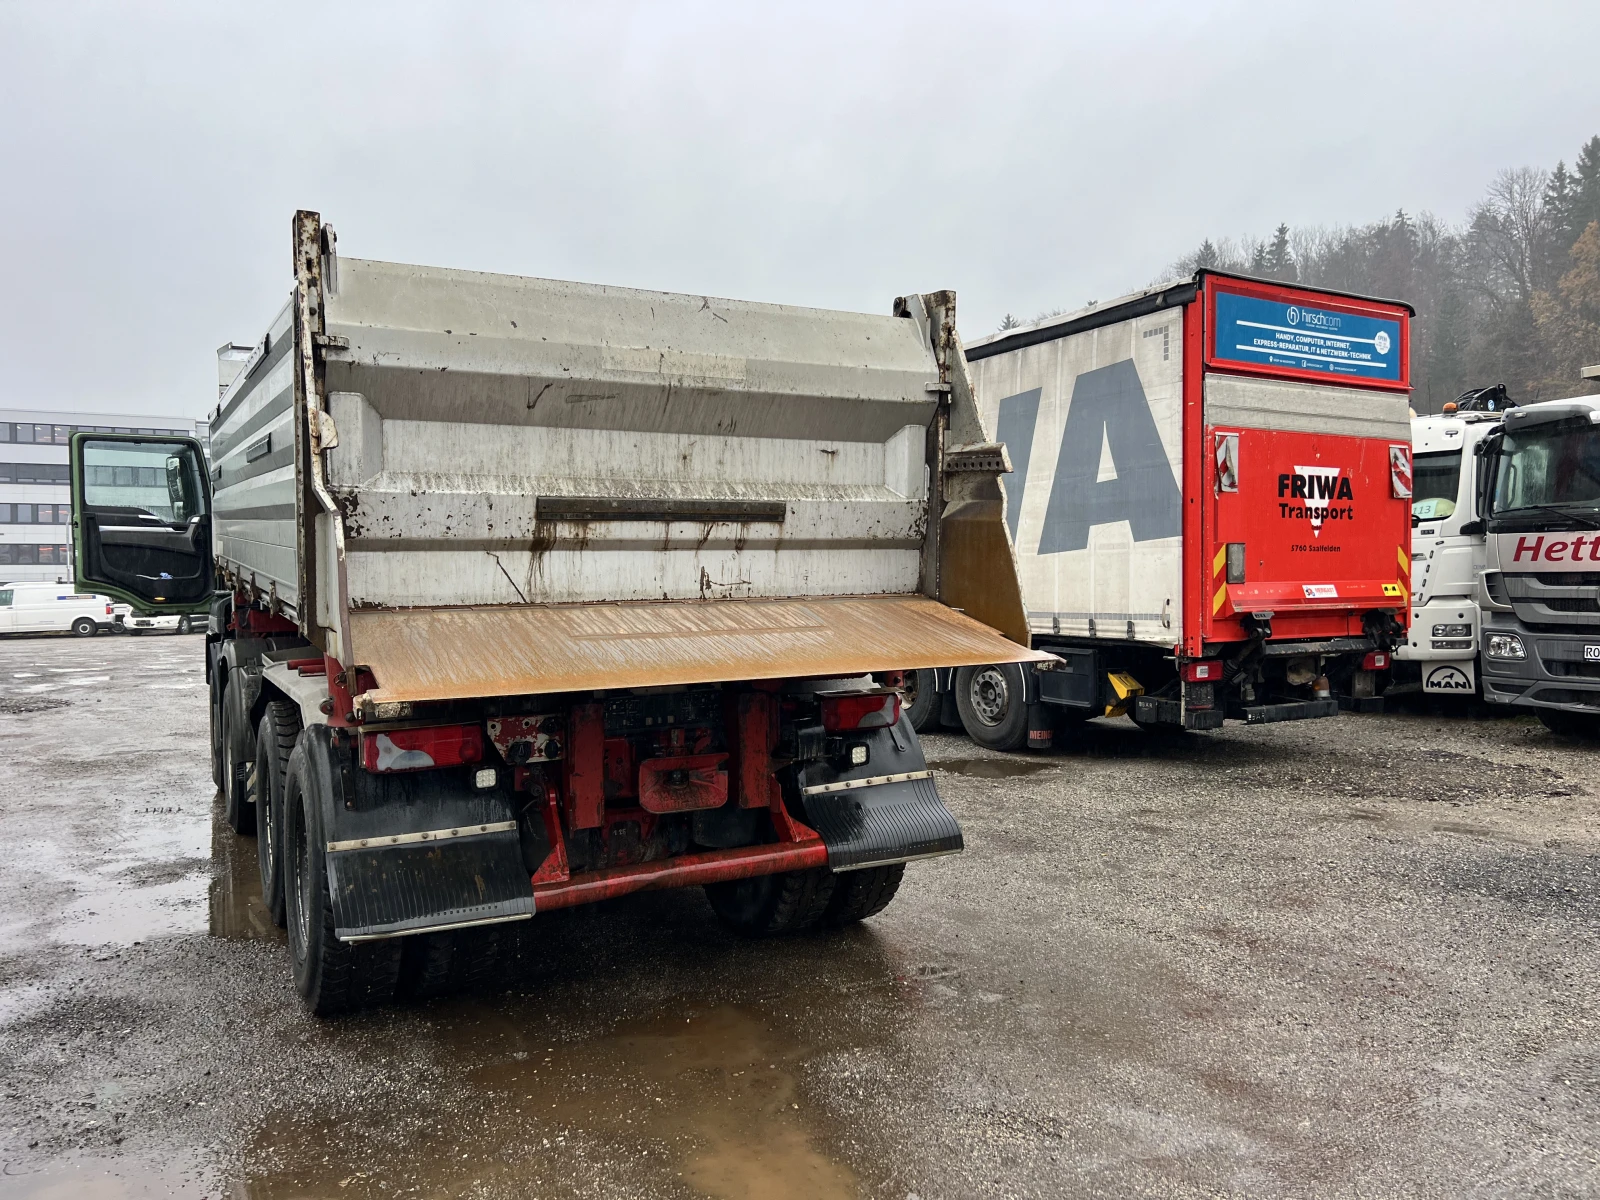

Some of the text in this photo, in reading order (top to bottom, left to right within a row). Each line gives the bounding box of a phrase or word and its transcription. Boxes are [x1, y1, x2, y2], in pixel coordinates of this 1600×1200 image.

[1301, 309, 1341, 327] hirschcom
[1253, 338, 1311, 354] EXPRESS-REPARATUR,
[1320, 348, 1372, 360] NETZWERK-TECHNIK
[1275, 333, 1352, 351] HANDY, COMPUTER, INTERNET,
[1278, 474, 1354, 500] FRIWA
[1278, 503, 1354, 524] Transport
[1429, 680, 1468, 690] MAN
